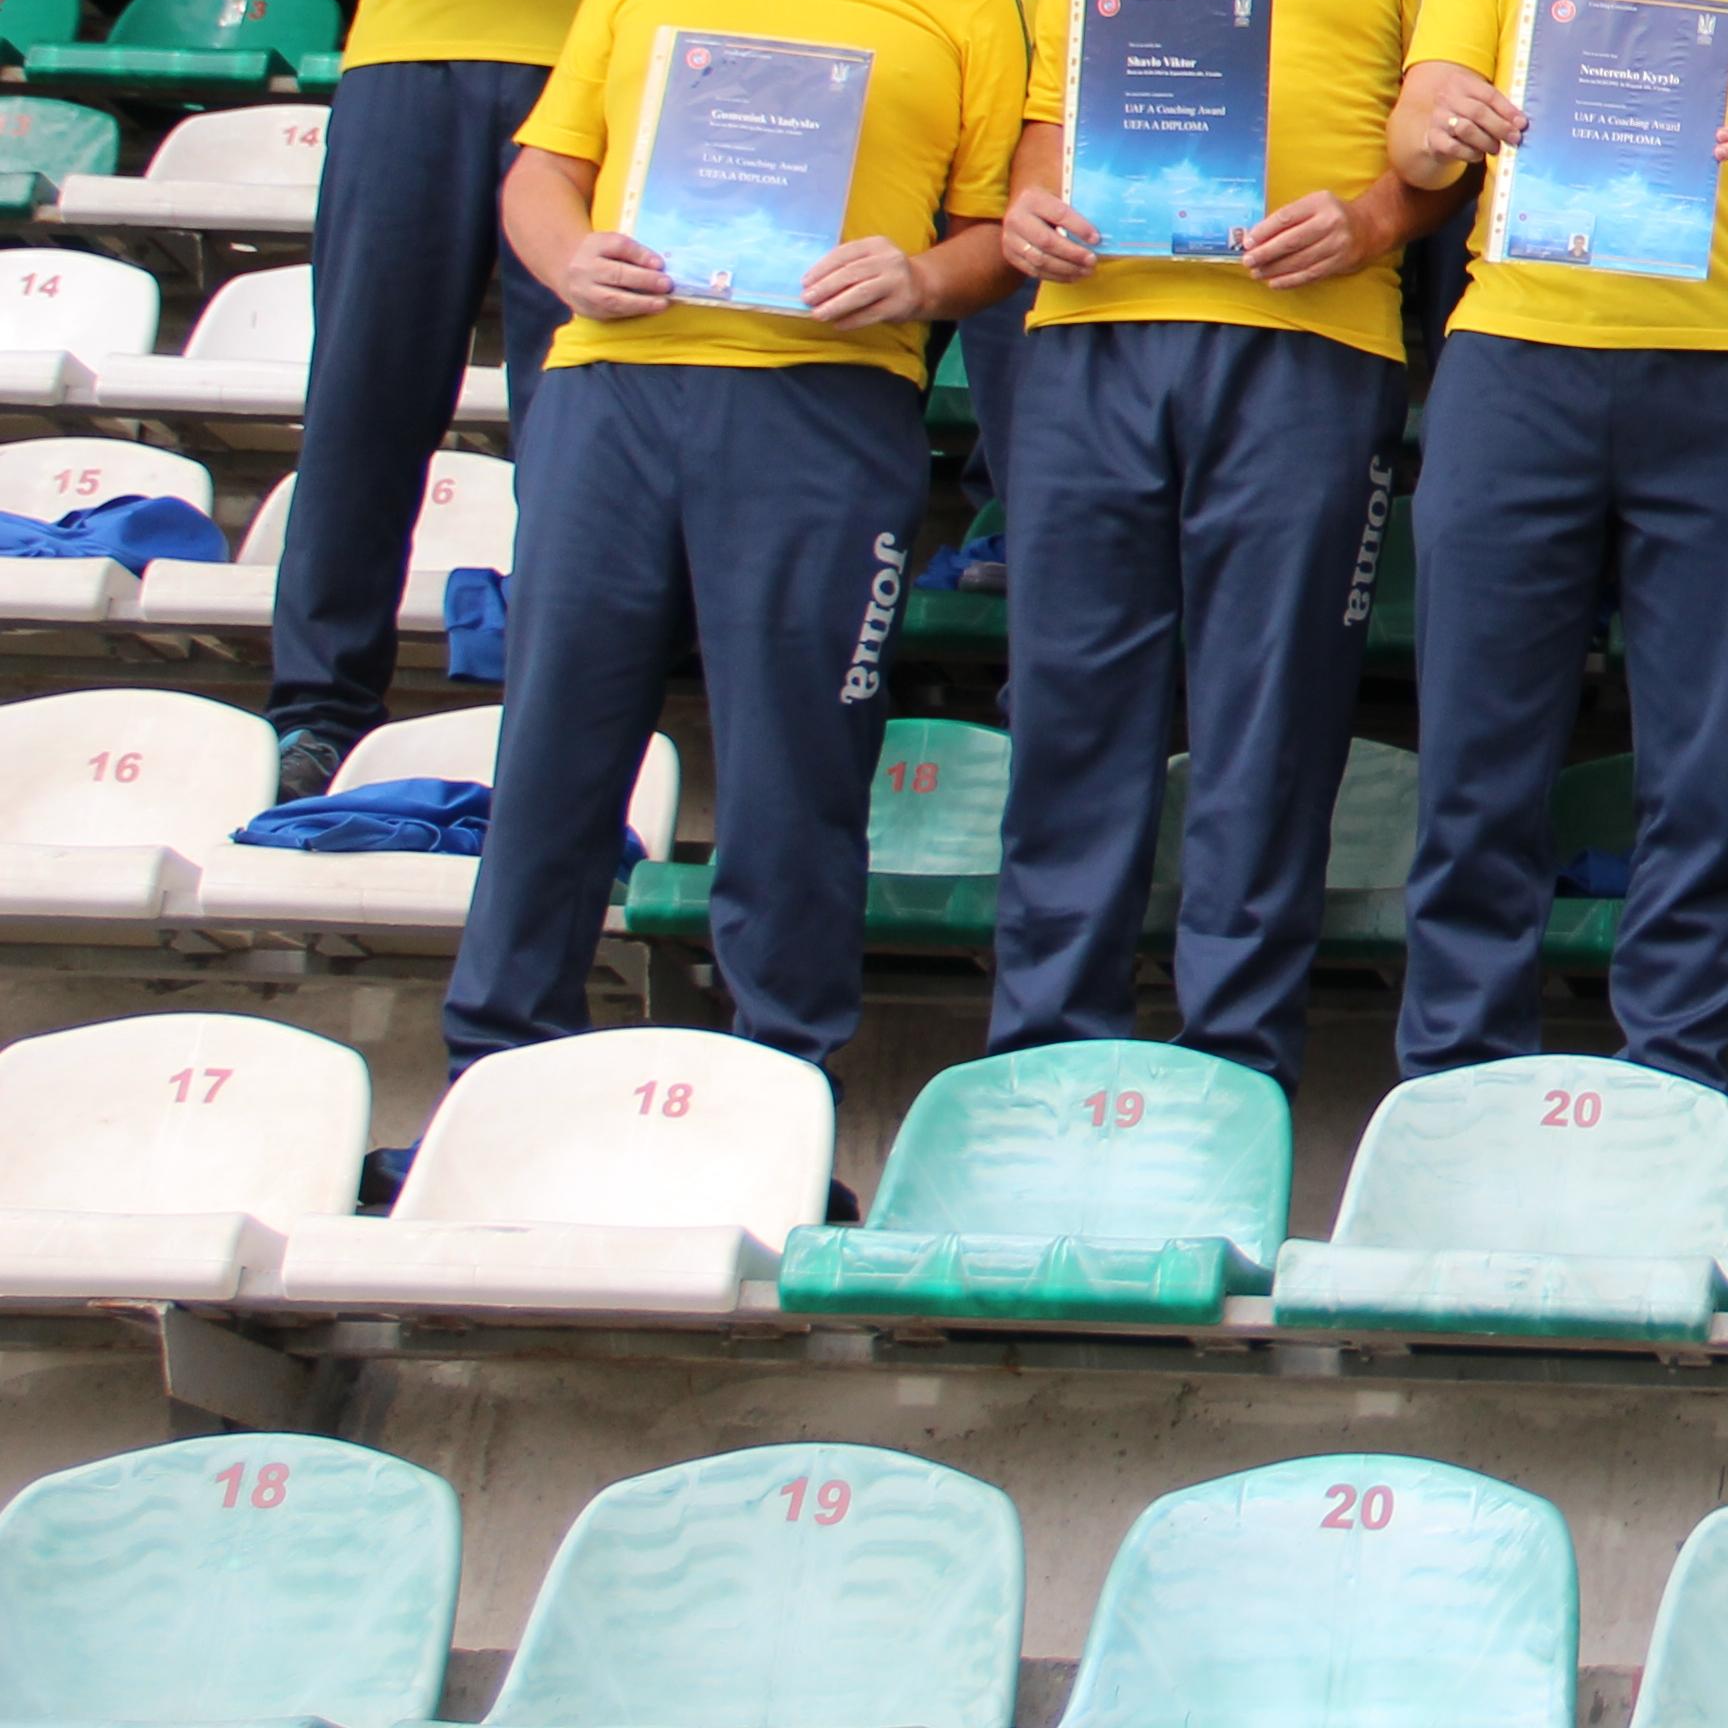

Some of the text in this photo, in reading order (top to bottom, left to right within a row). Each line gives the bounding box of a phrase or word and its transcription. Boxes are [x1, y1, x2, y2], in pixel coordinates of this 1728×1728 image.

[248, 0, 268, 21] 3
[1164, 56, 1197, 69] Viktor
[1580, 64, 1640, 79] Nesterenko
[1643, 71, 1681, 86] Kyrylo
[1125, 103, 1226, 116] UAF A Coaching Award
[1574, 112, 1681, 132] UAF A Coaching Award
[282, 124, 320, 148] 14
[1124, 120, 1209, 132] UEFA A DIPLOMA
[1572, 128, 1662, 146] UEFA A DIPLOMA
[703, 153, 808, 172] UAF A Coaching Award
[699, 169, 789, 186] UEFA A DIPLOMA
[20, 273, 62, 298] 14
[53, 467, 102, 496] 15
[431, 477, 455, 505] 6
[1342, 455, 1392, 627] Joma
[840, 531, 909, 705] Joma
[87, 750, 143, 783] 16
[887, 761, 940, 795] 18
[168, 1067, 233, 1103] 17
[631, 1081, 694, 1119] 18
[1083, 1089, 1145, 1128] 19
[1543, 1090, 1601, 1127] 20
[214, 1462, 289, 1509] 18
[780, 1477, 852, 1527] 19
[1322, 1485, 1393, 1529] 20
